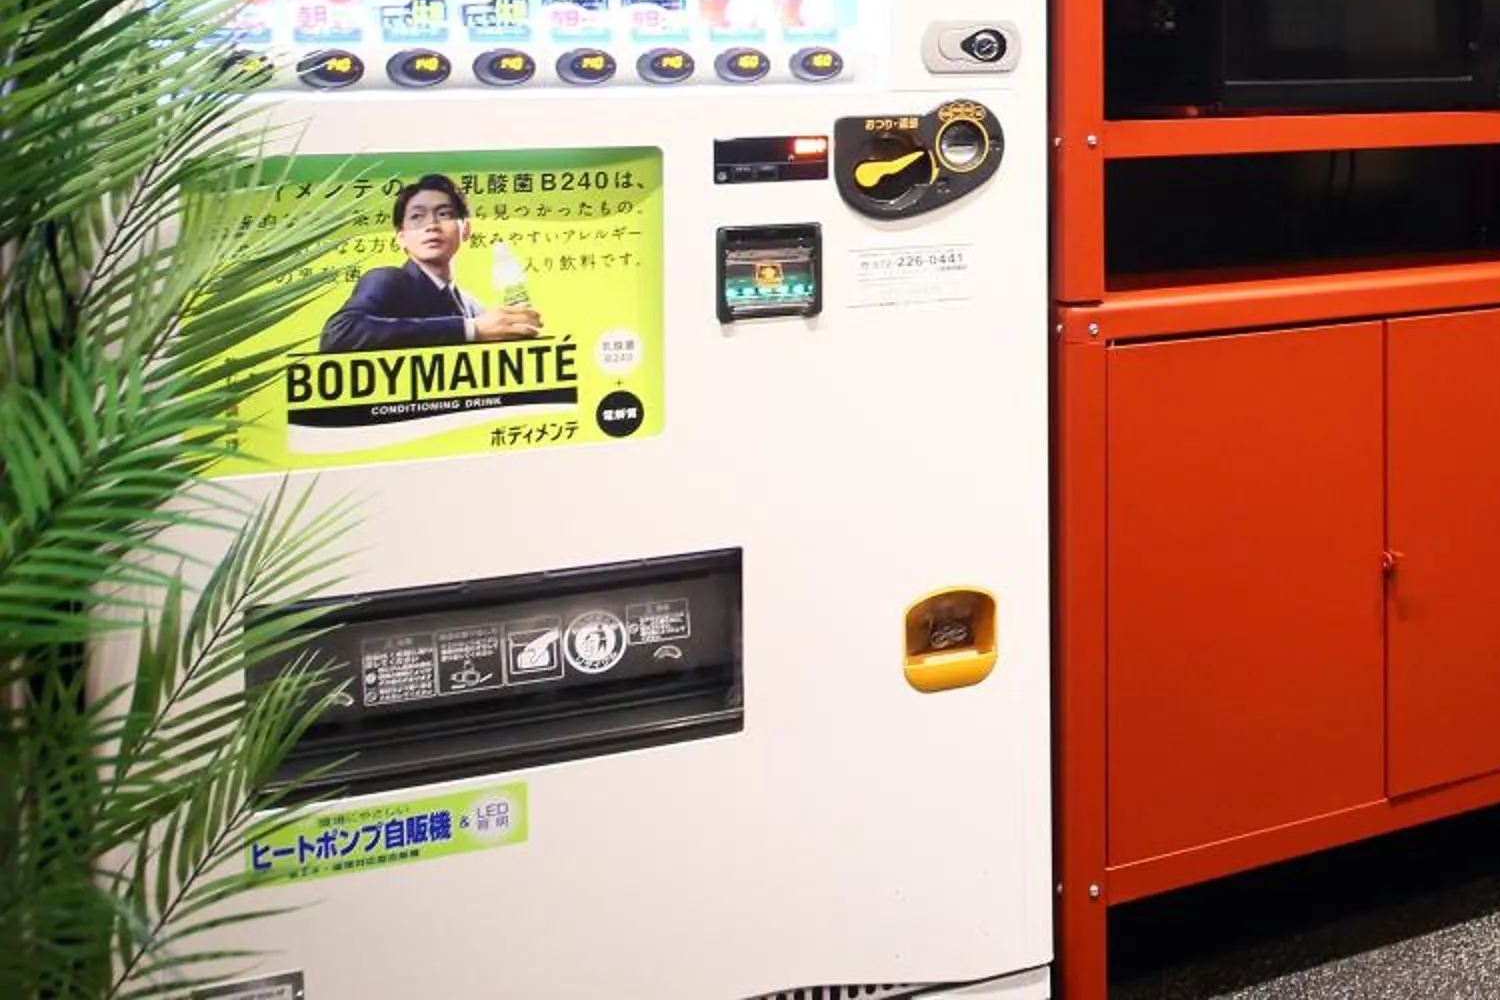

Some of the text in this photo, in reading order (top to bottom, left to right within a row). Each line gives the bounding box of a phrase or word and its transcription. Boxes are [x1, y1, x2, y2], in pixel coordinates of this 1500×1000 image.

[287, 334, 577, 403] BODYMAINTÉ
[371, 397, 502, 415] CONDITIONING DRINK
[490, 420, 579, 447] ボディメンテ
